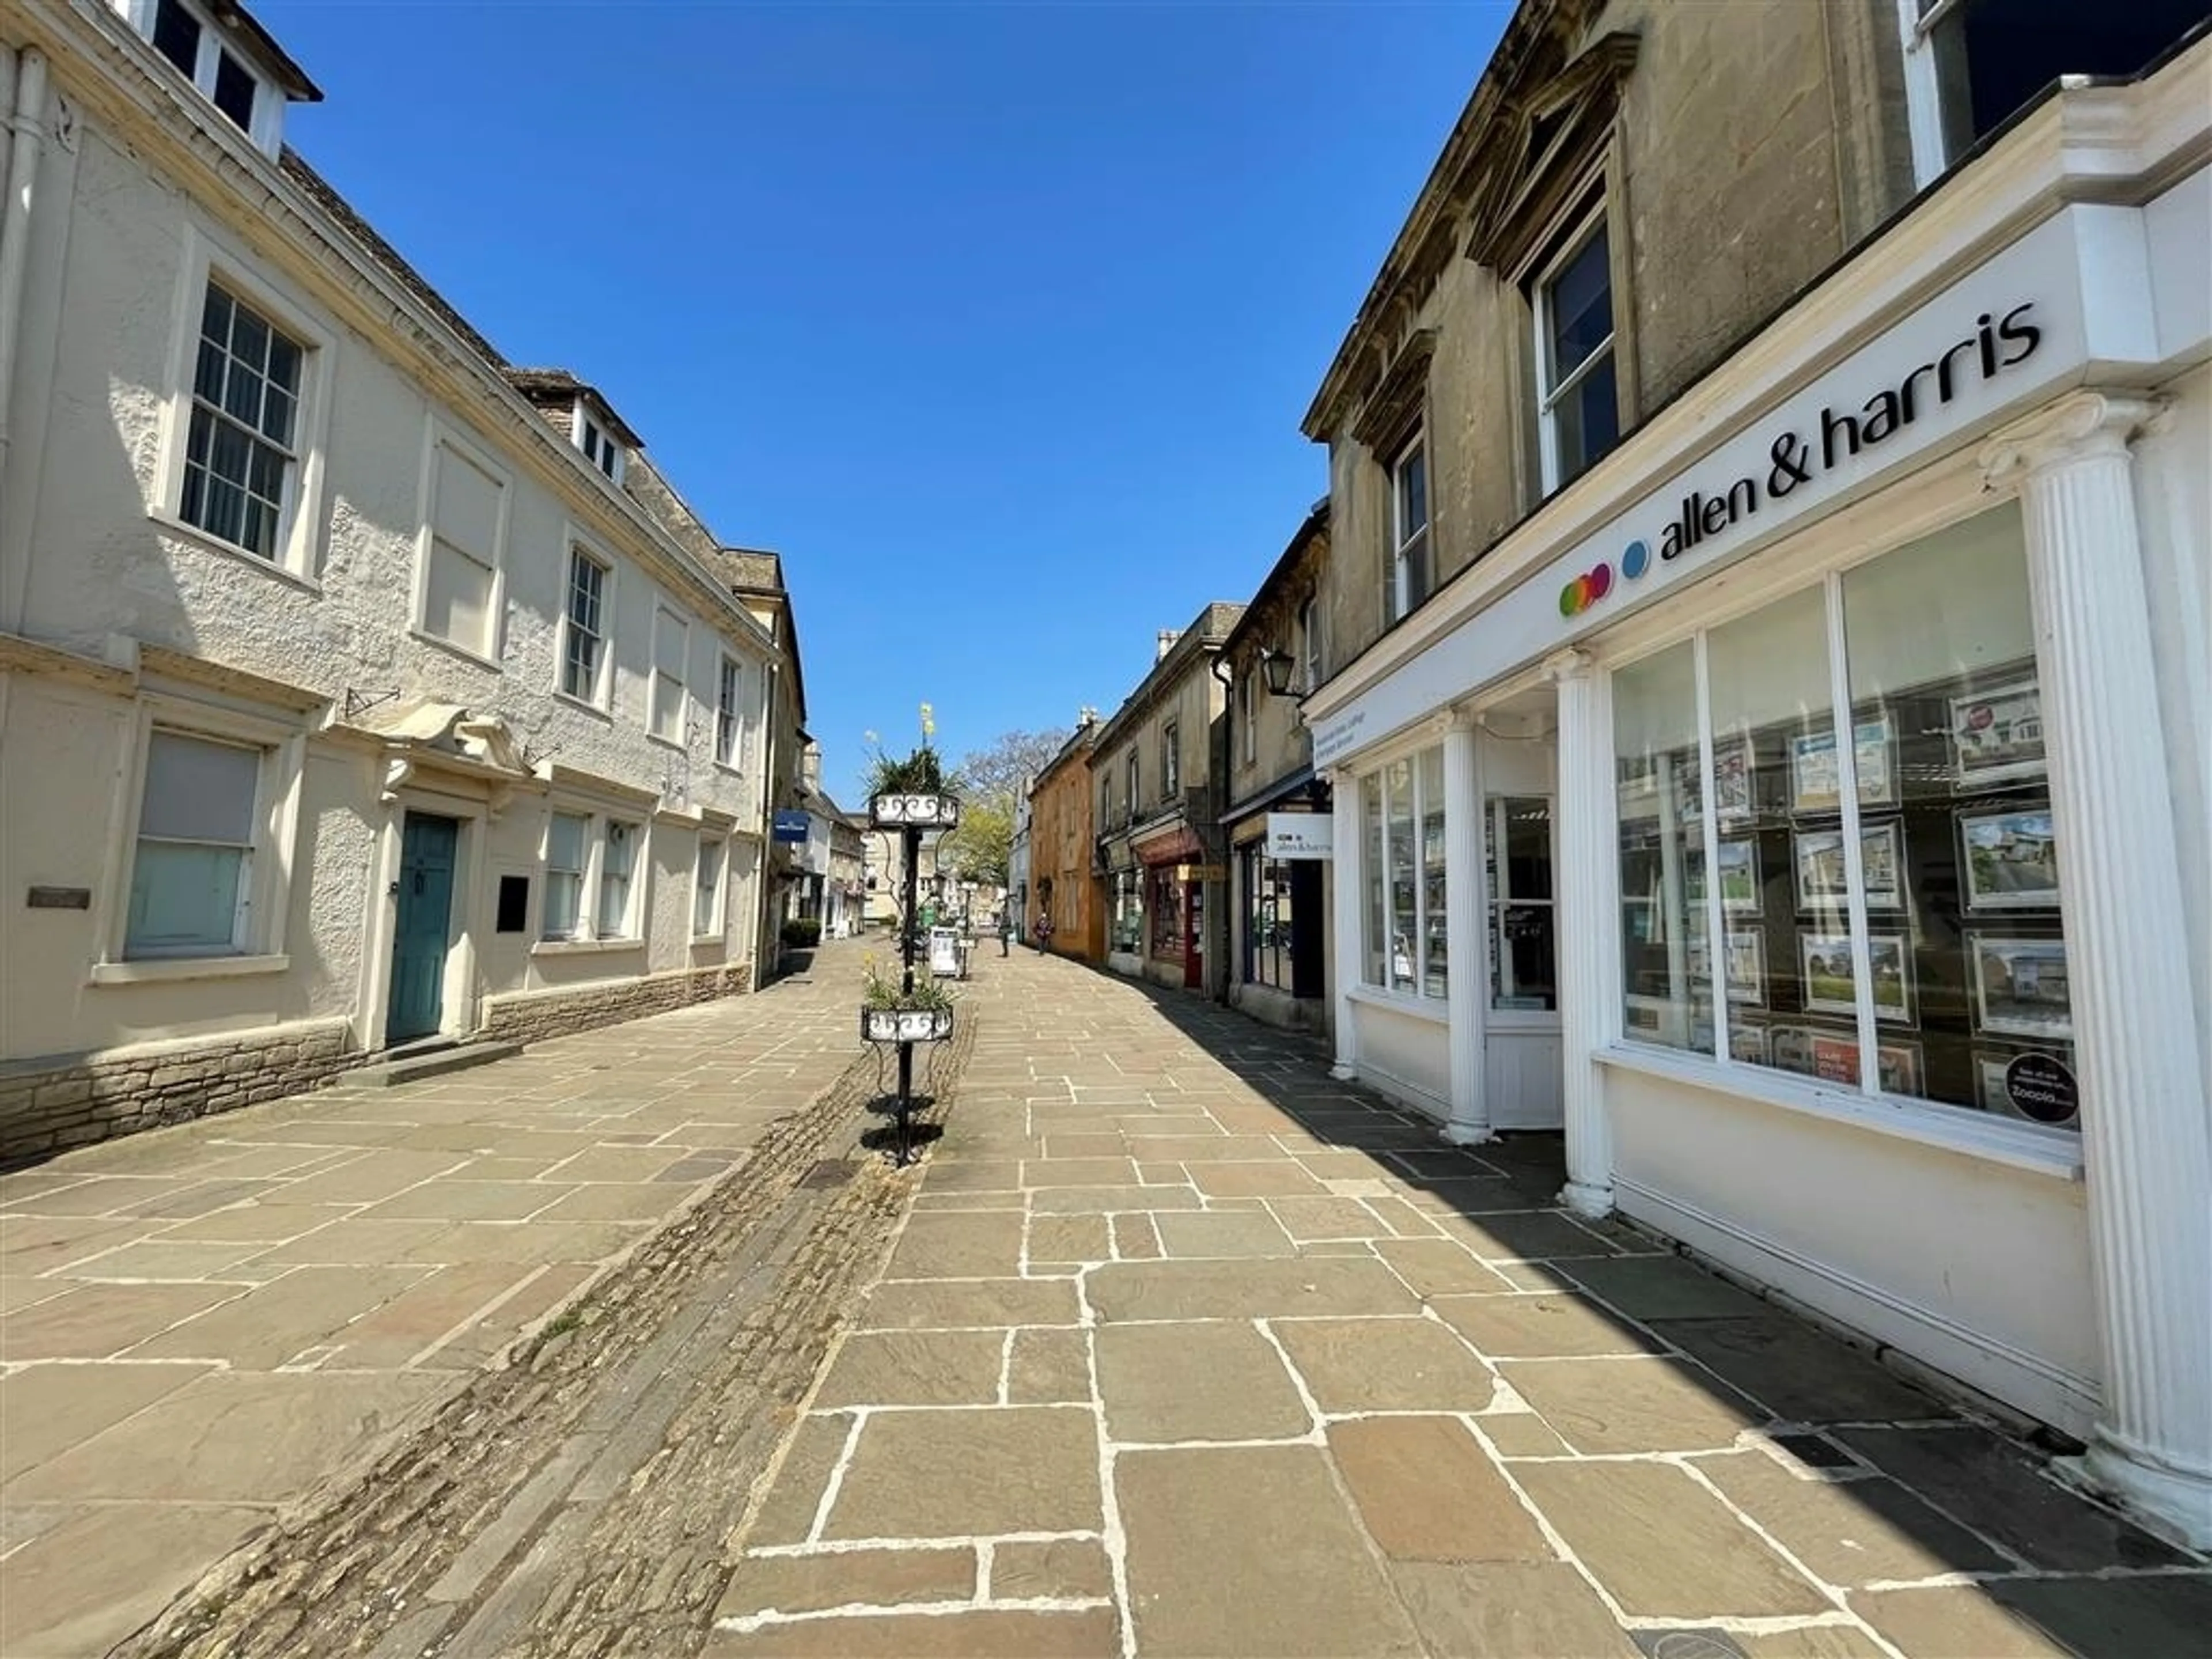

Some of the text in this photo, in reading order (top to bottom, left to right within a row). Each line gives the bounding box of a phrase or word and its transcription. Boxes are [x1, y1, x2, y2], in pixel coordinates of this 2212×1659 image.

[1661, 302, 2040, 560] allen & harris
